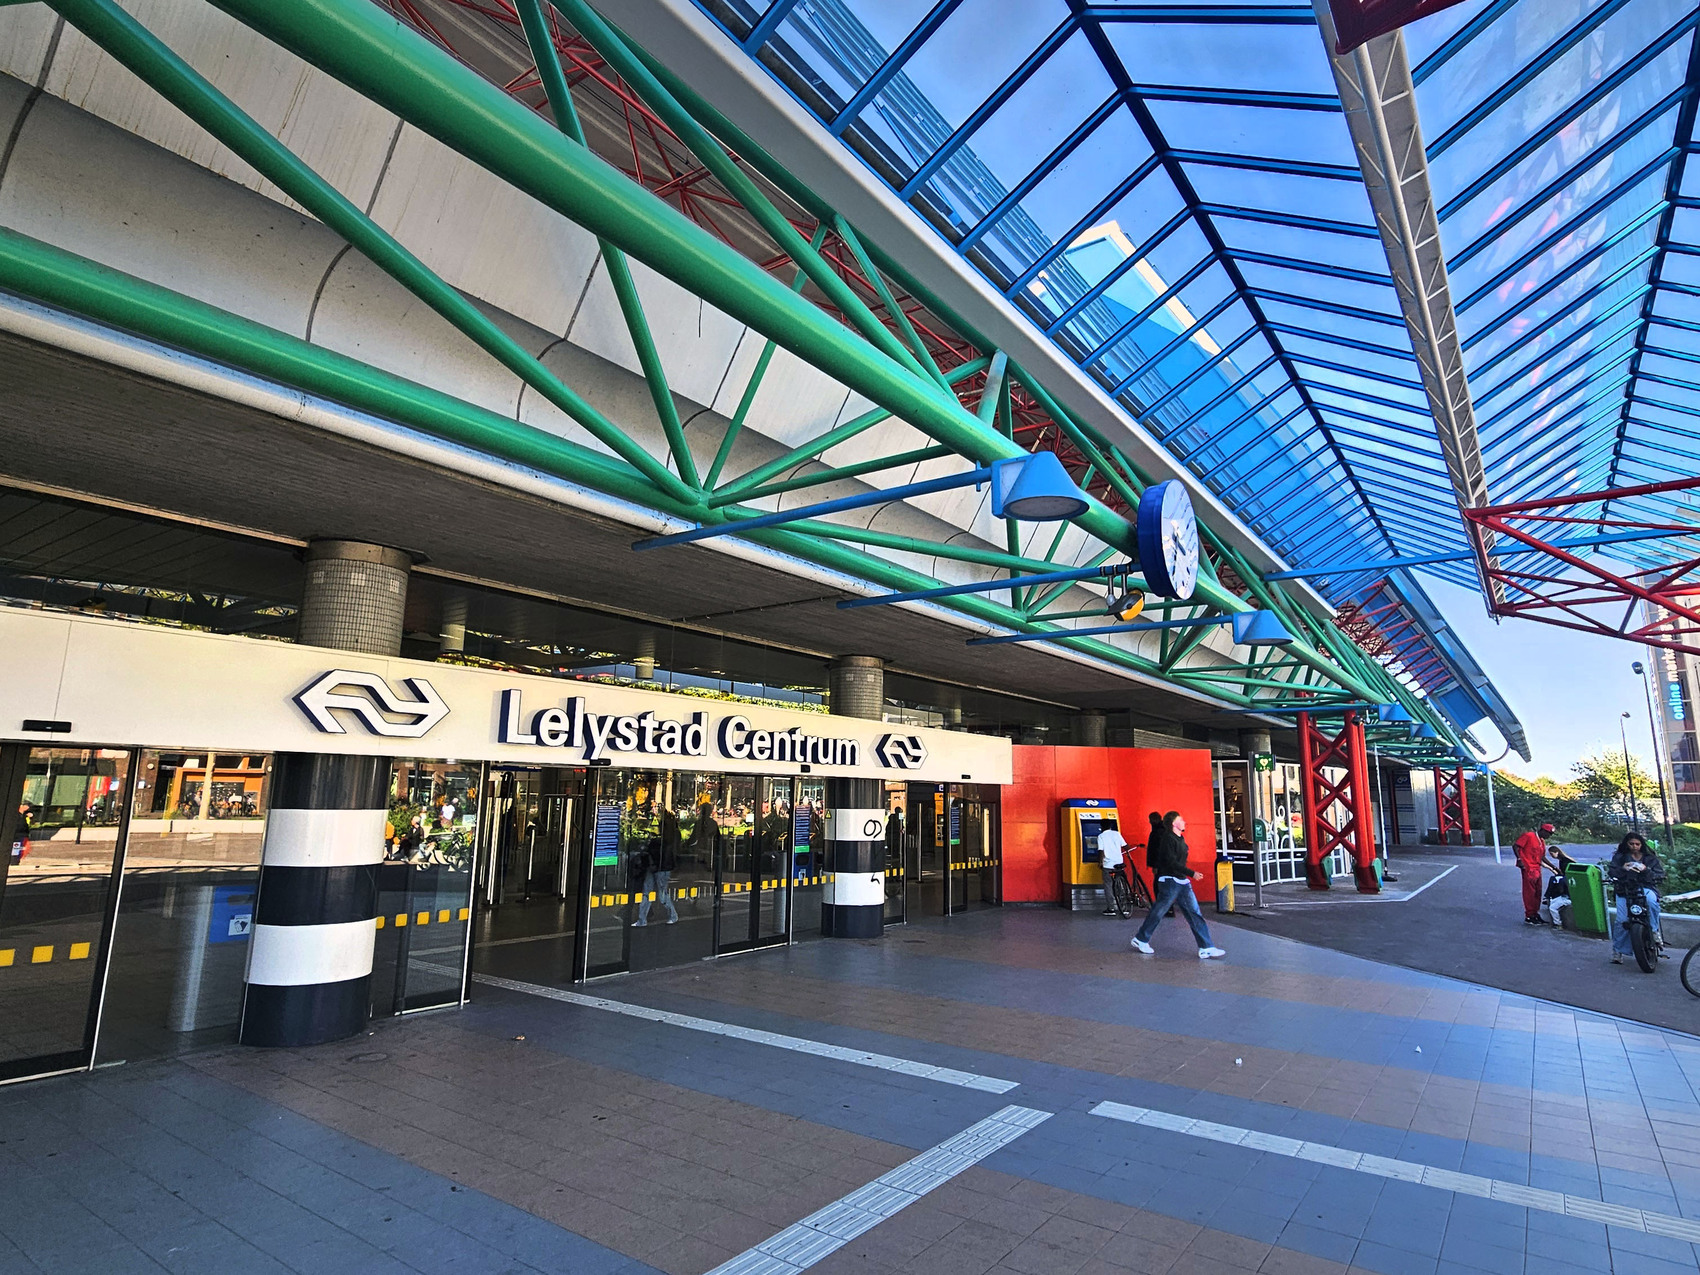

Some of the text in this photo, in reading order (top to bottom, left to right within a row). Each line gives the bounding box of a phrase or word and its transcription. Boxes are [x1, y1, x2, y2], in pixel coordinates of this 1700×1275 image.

[499, 689, 860, 766] Lelystad Centrum
[1669, 682, 1685, 720] online
